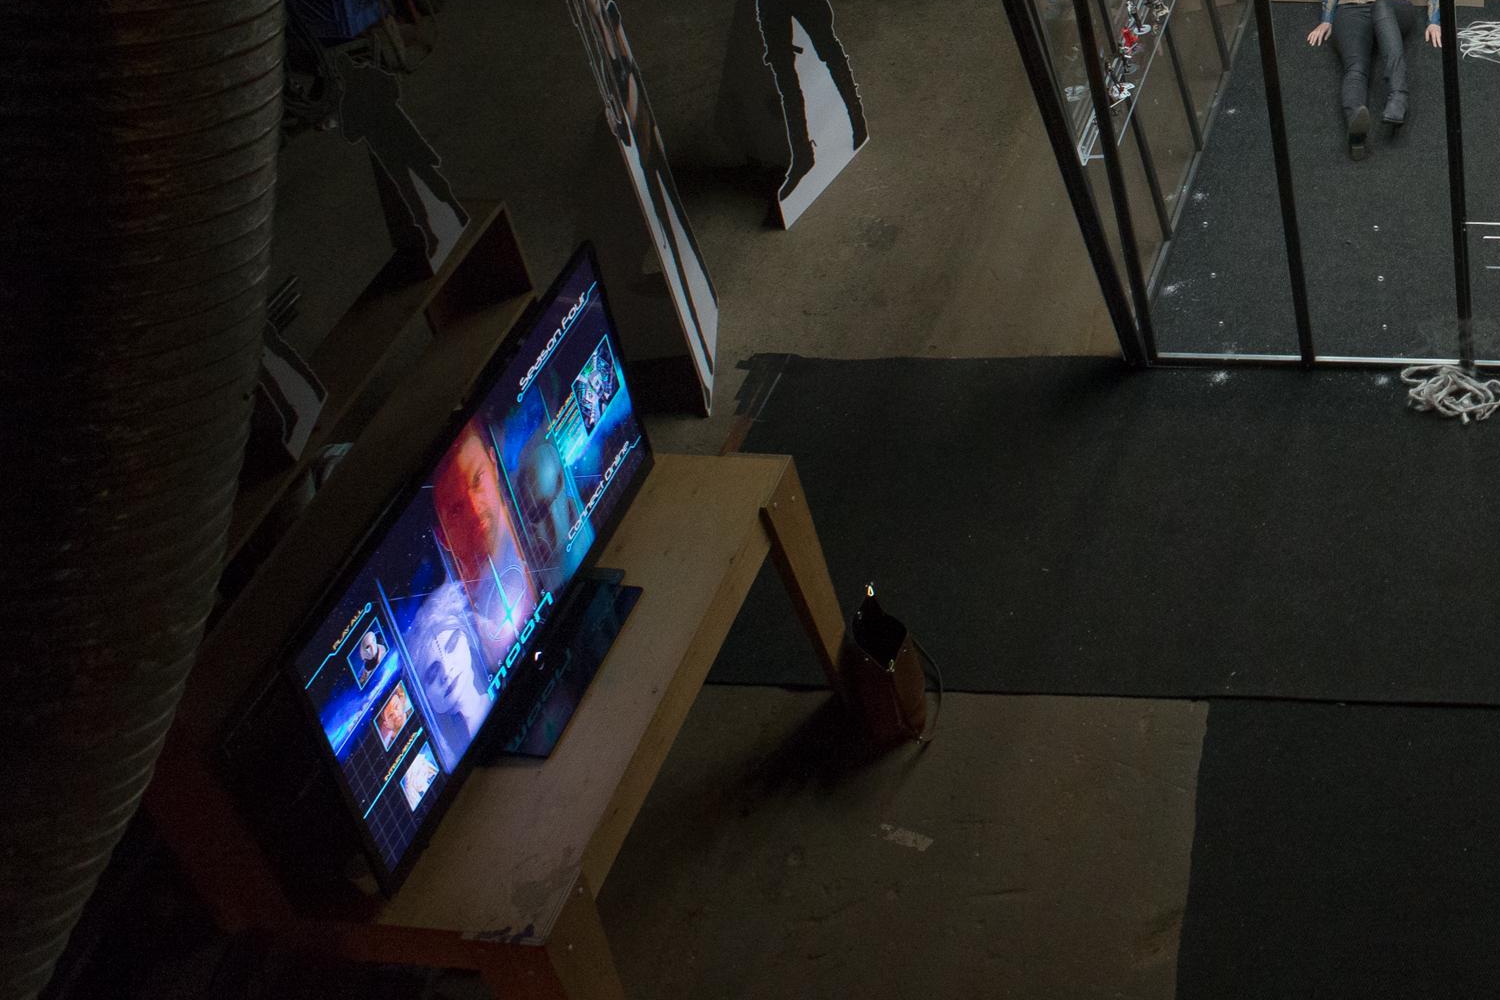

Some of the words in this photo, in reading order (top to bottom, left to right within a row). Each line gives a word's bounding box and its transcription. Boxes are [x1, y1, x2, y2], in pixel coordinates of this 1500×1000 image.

[520, 329, 561, 390] Season
[561, 292, 585, 330] Four
[568, 479, 604, 540] Connect
[604, 441, 629, 481] Online
[350, 608, 363, 628] ALL
